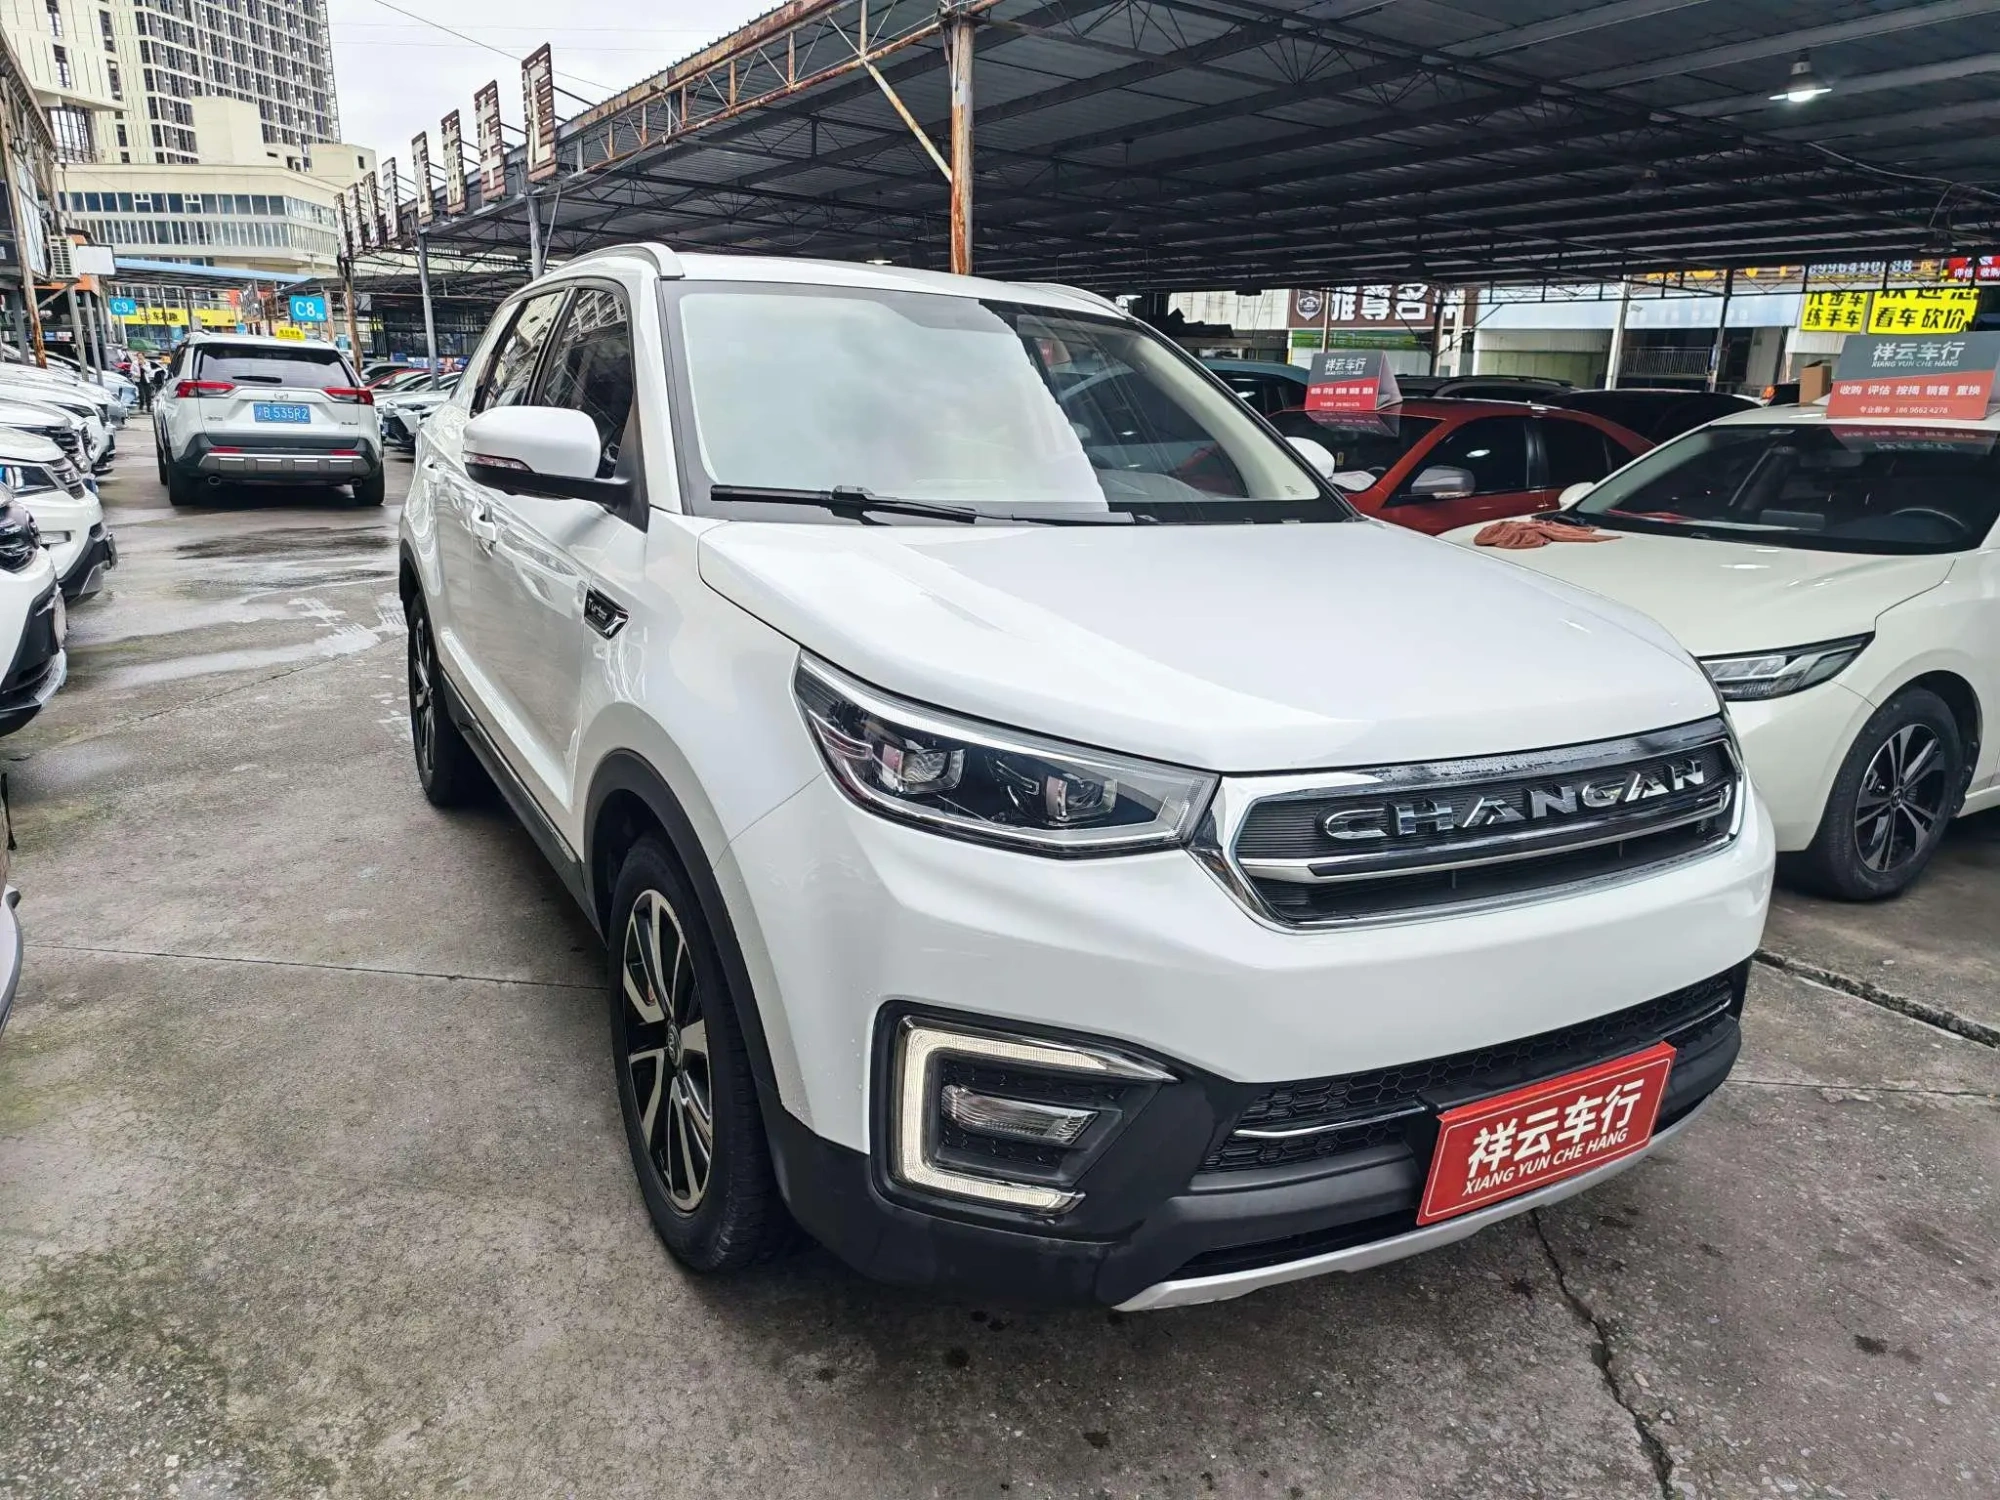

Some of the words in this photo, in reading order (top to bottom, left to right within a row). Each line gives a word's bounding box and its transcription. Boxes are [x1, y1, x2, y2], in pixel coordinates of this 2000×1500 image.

[113, 301, 129, 313] C9
[295, 301, 316, 317] C8
[1804, 307, 1862, 328] 练手车
[1875, 306, 1966, 329] 看车砍价
[1873, 341, 1966, 361] 祥云车行
[1324, 357, 1367, 372] 祥云车行
[1867, 385, 1891, 396] 评估
[1317, 758, 1705, 840] CHANGAN
[1467, 1078, 1645, 1178] 祥云车行
[1462, 1166, 1515, 1196] XIANG
[1518, 1154, 1551, 1178] YUN
[1553, 1144, 1585, 1165] CHE
[1586, 1128, 1629, 1155] HANG
